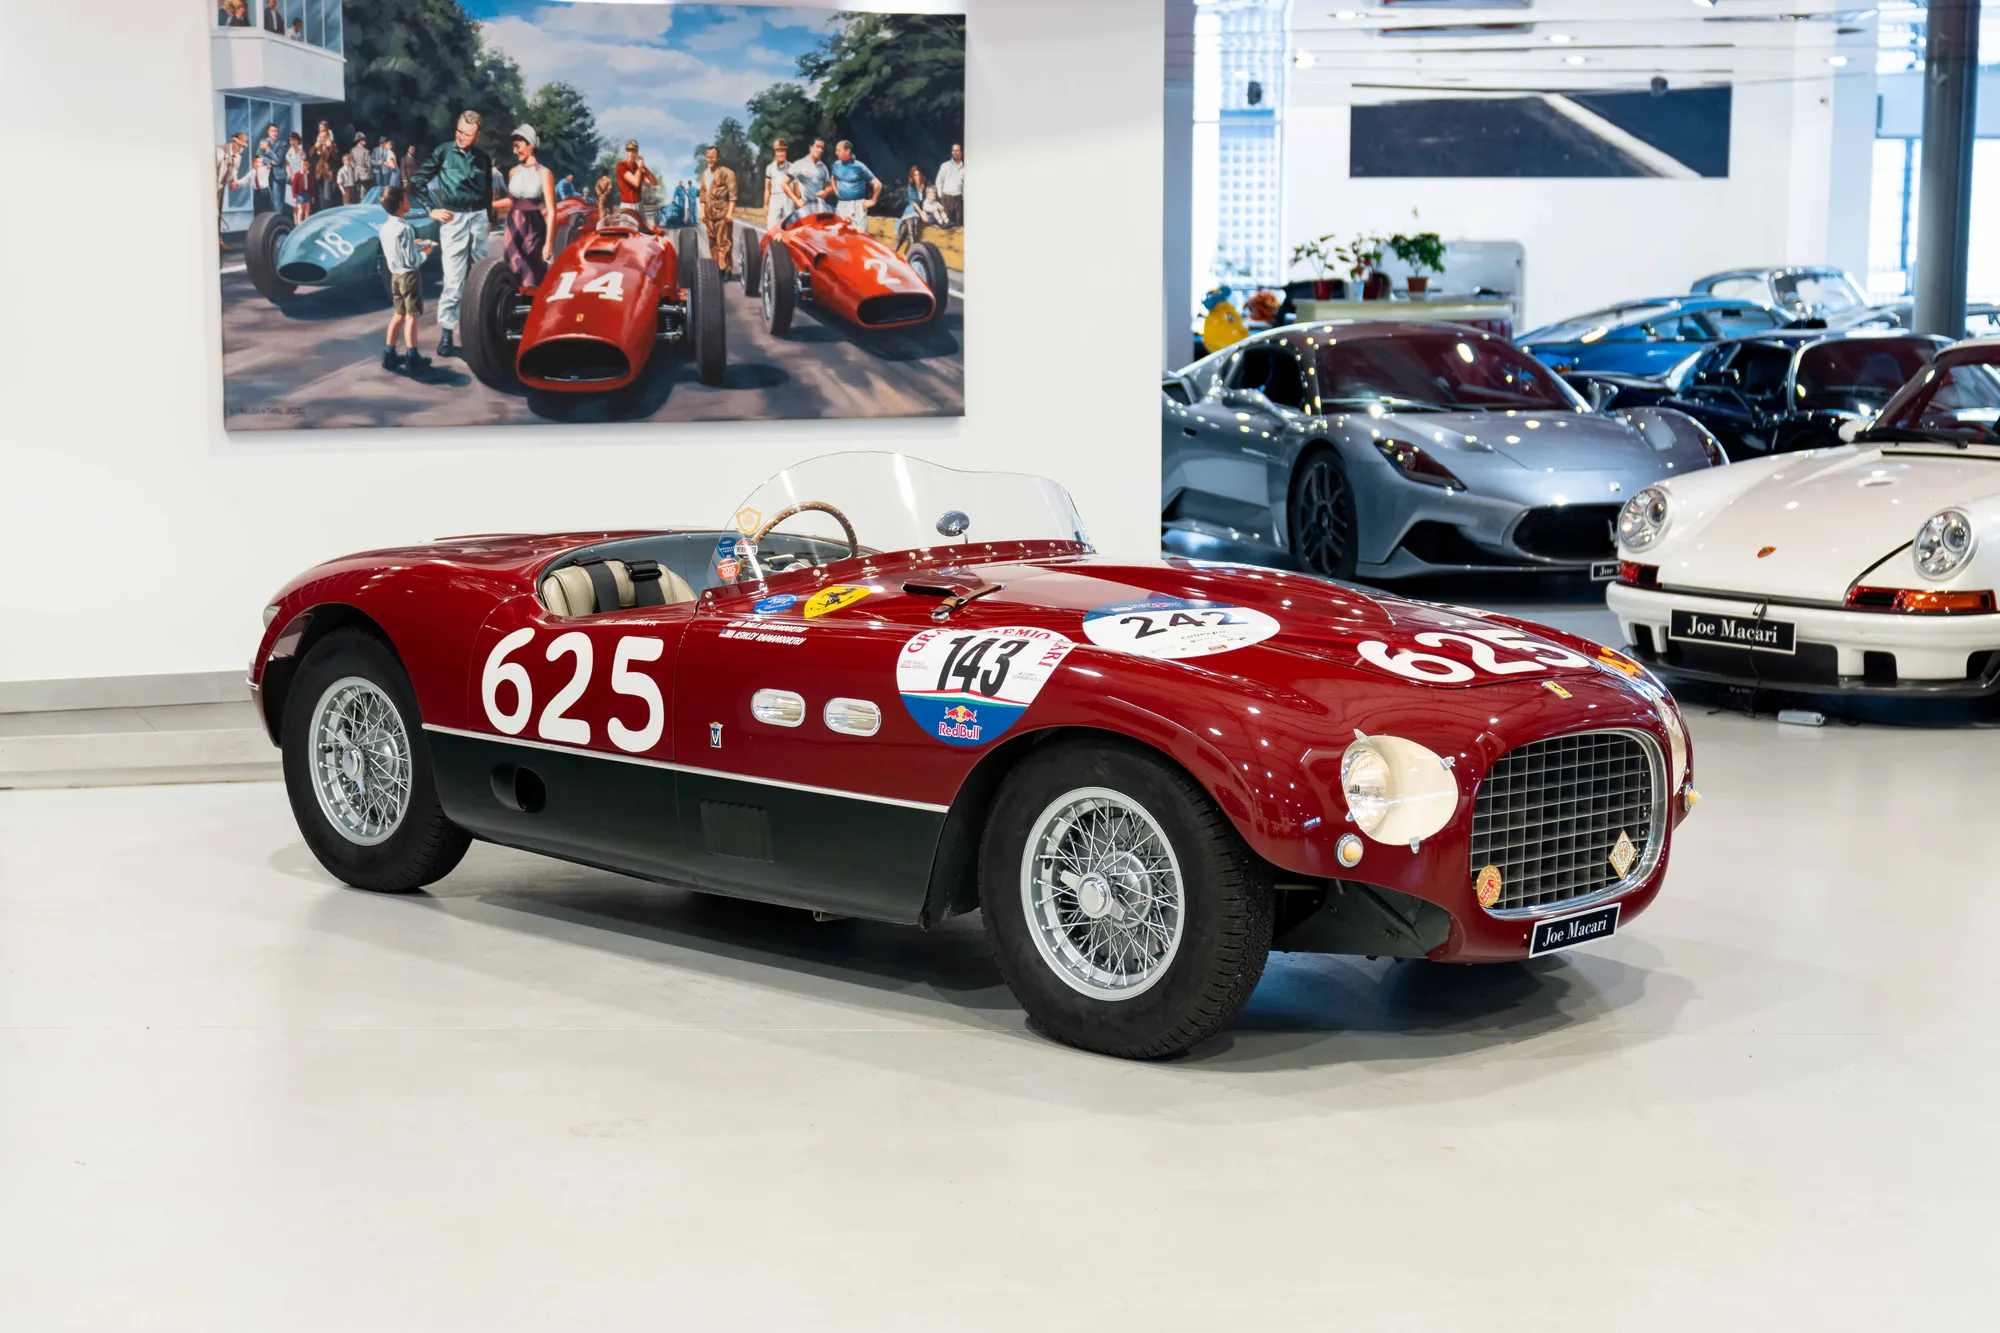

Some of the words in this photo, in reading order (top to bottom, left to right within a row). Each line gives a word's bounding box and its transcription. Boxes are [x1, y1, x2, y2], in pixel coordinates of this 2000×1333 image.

[314, 231, 355, 259] 18
[864, 258, 901, 285] 2
[546, 271, 624, 303] 14
[1599, 565, 1614, 576] Joe
[733, 630, 760, 641] ASHLEY
[1119, 611, 1249, 639] 242
[1687, 615, 1715, 636] Joe
[1720, 618, 1778, 644] Macari
[936, 635, 1030, 697] 143
[1037, 638, 1070, 669] ARI
[1356, 629, 1590, 683] 625
[481, 627, 665, 752] 625
[938, 721, 959, 738] Red
[959, 723, 980, 740] Bull
[1542, 926, 1565, 947] Joe
[1566, 913, 1608, 940] Macari
